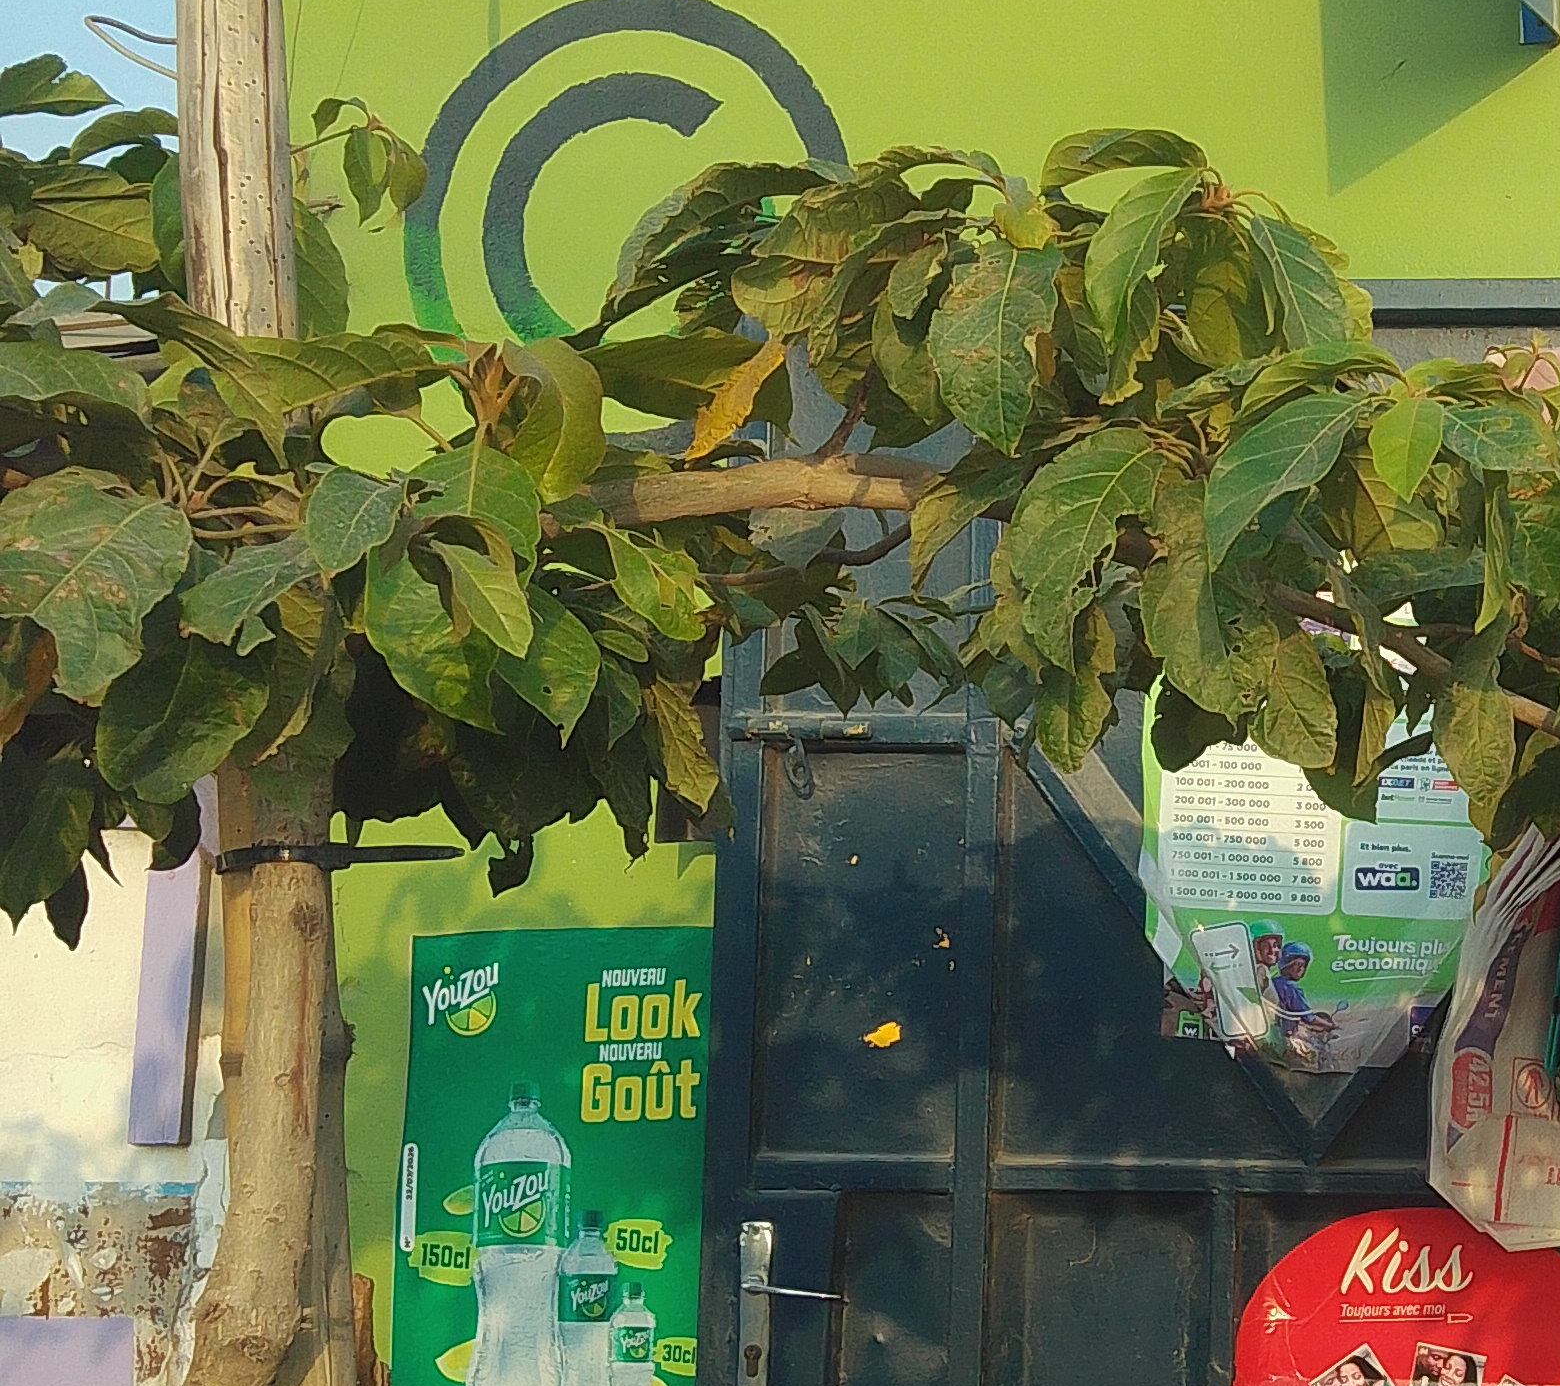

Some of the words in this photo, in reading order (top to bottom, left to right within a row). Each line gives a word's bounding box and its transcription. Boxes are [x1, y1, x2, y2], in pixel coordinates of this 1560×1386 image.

[1191, 760, 1210, 769] 001
[1220, 761, 1238, 769] 100
[1240, 762, 1262, 771] 000
[1175, 777, 1194, 786] 100
[1196, 777, 1215, 786] 001
[1224, 779, 1245, 788] 200
[1248, 780, 1270, 789] 000
[1174, 796, 1195, 804] 200
[1197, 797, 1216, 806] 001
[1225, 798, 1246, 807] 300
[1248, 799, 1270, 808] 000
[1304, 802, 1326, 811] 000
[1173, 814, 1194, 823] 300
[1196, 815, 1215, 824] 001
[1224, 816, 1245, 825] 500
[1247, 817, 1269, 827] 000
[1303, 821, 1325, 830] 500
[1172, 832, 1193, 841] 500
[1195, 833, 1214, 842] 001
[1223, 834, 1243, 844] 750
[1245, 836, 1267, 845] 000
[1303, 839, 1325, 848] 000
[1171, 850, 1191, 859] 750
[1193, 852, 1212, 860] 001
[1227, 853, 1250, 862] 000
[1252, 854, 1274, 864] 000
[1302, 857, 1323, 866] 800
[1378, 863, 1398, 871] avec
[1178, 869, 1199, 878] 000
[1201, 870, 1220, 879] 001
[1236, 872, 1257, 881] 500
[1259, 873, 1281, 883] 000
[1300, 876, 1322, 885] 800
[1176, 887, 1197, 896] 500
[1199, 888, 1218, 897] 001
[1236, 891, 1258, 900] 000
[1260, 892, 1282, 901] 000
[1299, 894, 1321, 903] 800
[1332, 934, 1416, 956] Toujours
[1419, 936, 1452, 956] plu
[1331, 957, 1440, 975] économiqu
[602, 968, 667, 988] NOUVEAU
[584, 979, 702, 1043] Look
[599, 1042, 663, 1062] NOUVEAU
[580, 1059, 700, 1123] Goût
[615, 1228, 660, 1255] 50cl
[421, 1243, 471, 1270] 150cl
[1340, 1226, 1474, 1295] Kiss
[1341, 1303, 1391, 1319] Toujours
[1392, 1304, 1420, 1316] avec
[1423, 1304, 1446, 1315] moi
